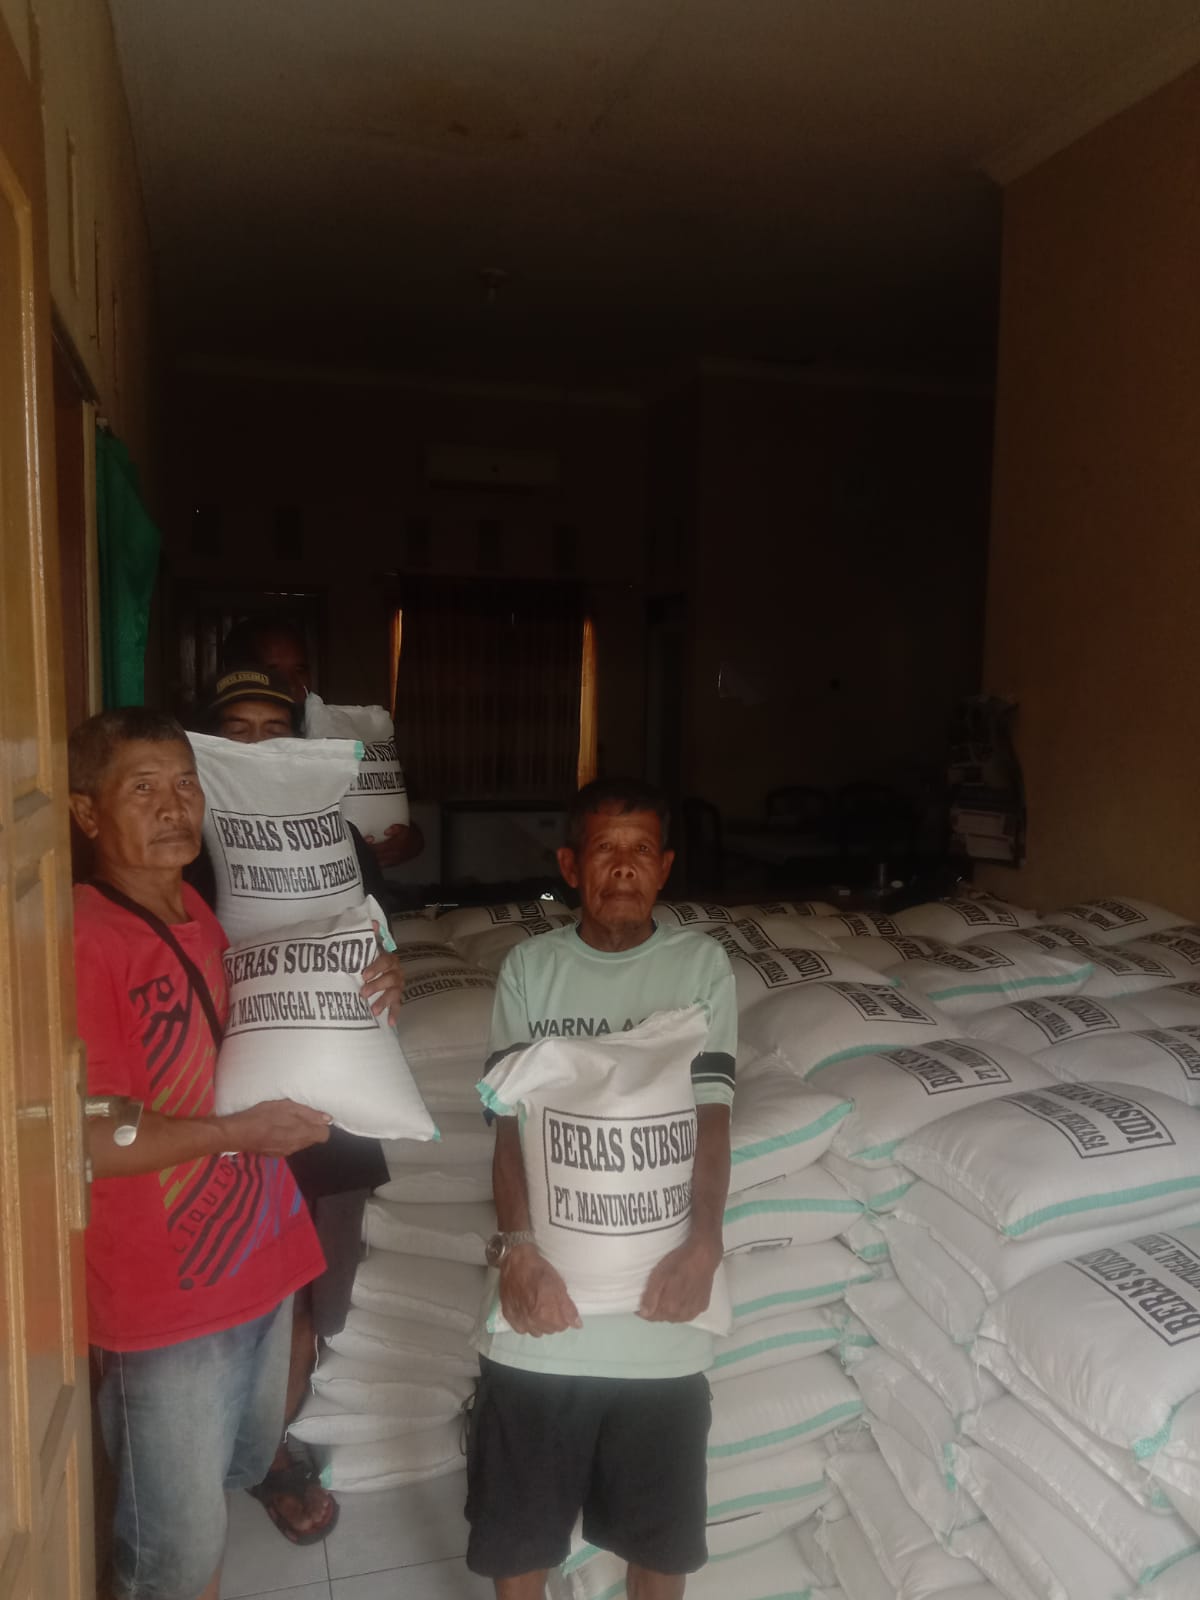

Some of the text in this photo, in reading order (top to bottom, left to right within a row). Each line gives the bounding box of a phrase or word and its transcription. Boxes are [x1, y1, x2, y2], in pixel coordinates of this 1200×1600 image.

[218, 816, 283, 851] BERAS
[248, 864, 320, 893] MANUNGGAL
[284, 937, 373, 974] SUBSIDI
[238, 990, 316, 1025] MANUNGGAL
[528, 1017, 612, 1038] WARNA
[549, 1119, 625, 1172] BERAS
[554, 1185, 573, 1222] PT.
[576, 1189, 663, 1227] MANUNGGAL
